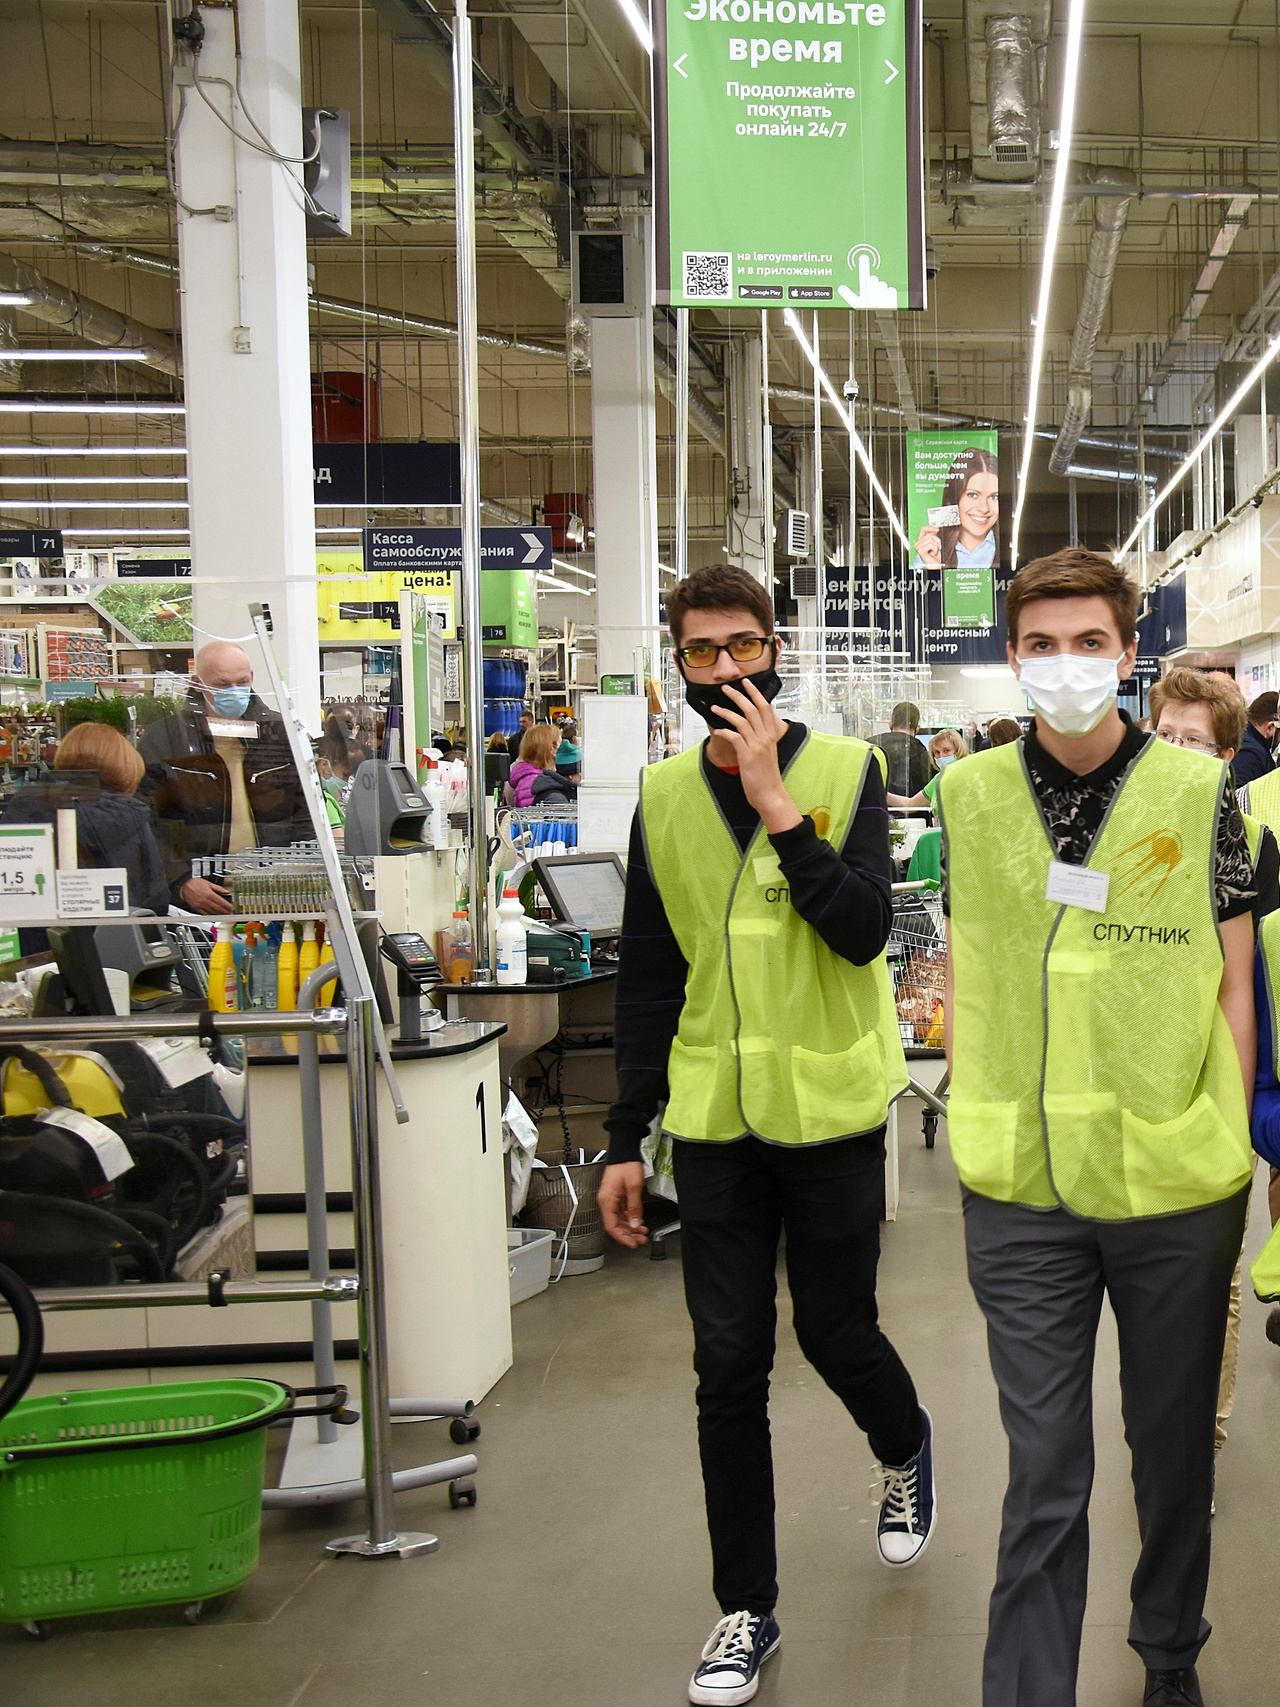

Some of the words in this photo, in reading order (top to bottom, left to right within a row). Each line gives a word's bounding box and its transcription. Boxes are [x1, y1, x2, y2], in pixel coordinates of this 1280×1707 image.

[683, 0, 886, 26] Экономьте
[729, 37, 842, 68] время
[726, 81, 856, 100] Продолжайте
[746, 102, 832, 120] покупать
[735, 121, 804, 137] онлайн
[807, 122, 847, 138] 24/7
[737, 253, 751, 261] на
[753, 251, 833, 263] leroymerlin.ru
[737, 266, 745, 274] и
[747, 266, 754, 274] в
[756, 266, 833, 277] приложении
[751, 289, 769, 297] Google
[914, 451, 932, 459] Вам
[932, 452, 974, 461] доступно
[914, 461, 950, 470] больше,
[927, 473, 965, 481] думаете
[42, 538, 55, 549] 71
[372, 532, 414, 545] Касса
[372, 545, 515, 560] самообслужания
[398, 559, 443, 568] банковскими
[181, 566, 192, 576] 72
[403, 571, 452, 589] цена!
[876, 575, 1014, 596] обслужия
[385, 606, 395, 614] 74
[825, 598, 904, 611] лиентов
[921, 627, 990, 640] Сервисный
[840, 641, 891, 652] бзнса
[0, 871, 24, 886] 1,5
[1093, 922, 1191, 945] СПУТНИК
[475, 1081, 489, 1155] 1
